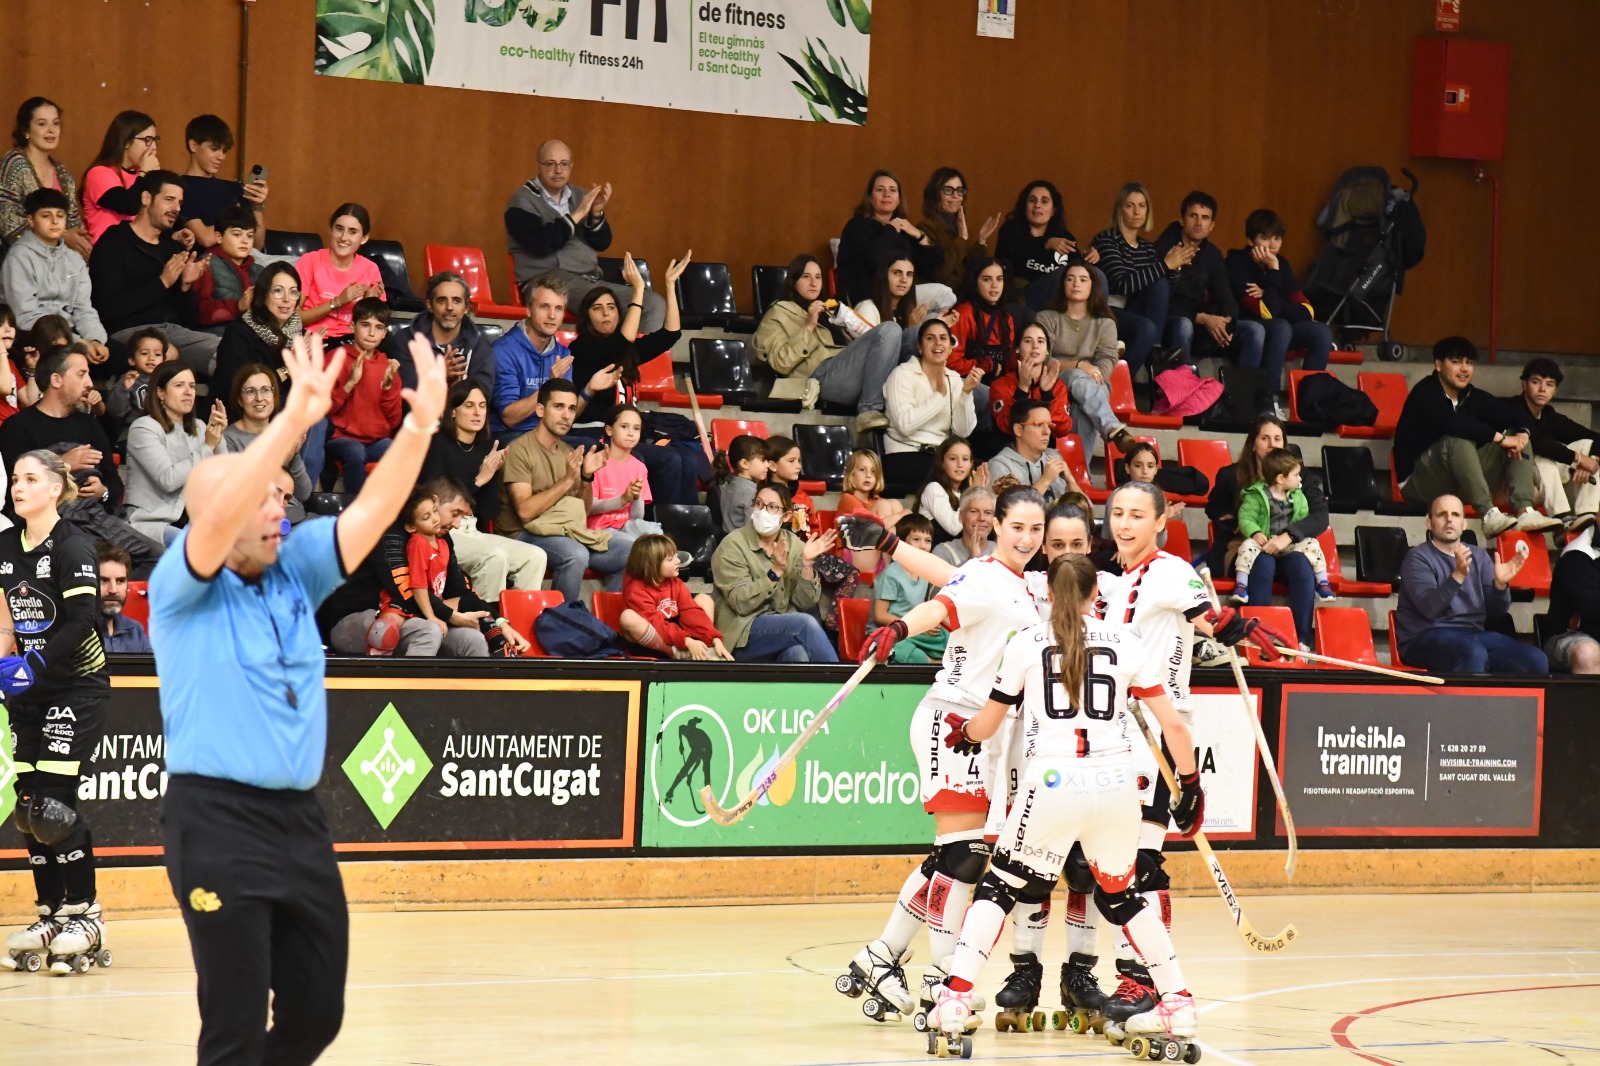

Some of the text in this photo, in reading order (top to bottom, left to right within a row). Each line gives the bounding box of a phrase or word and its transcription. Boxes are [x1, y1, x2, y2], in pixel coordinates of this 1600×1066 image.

[698, 1, 786, 30] de fitness
[698, 31, 765, 50] El teu gimnàs
[500, 44, 644, 70] eco-healthy fitness 24h
[698, 47, 760, 66] eco-healthy
[697, 61, 762, 80] a Sant Cugat
[9, 595, 44, 609] Estrella
[12, 606, 45, 621] Galicia
[23, 638, 47, 646] XUNTA
[1168, 635, 1184, 666] Cugat
[1041, 645, 1118, 722] 66
[743, 707, 777, 734] OK
[442, 734, 603, 759] AJUNTAMENT DE
[1317, 725, 1406, 749] Invisible
[1460, 744, 1469, 753] 20
[1469, 744, 1478, 753] 27
[1478, 744, 1487, 753] 59
[967, 757, 980, 780] 4
[1320, 748, 1402, 783] training
[1439, 758, 1518, 768] INVISIBLE-TRAINING.COM
[439, 761, 601, 806] SantCugat
[1010, 767, 1019, 793] 9
[1439, 773, 1456, 781] SANT
[1456, 773, 1478, 782] CUGAT
[1478, 773, 1492, 782] DEL
[1303, 787, 1341, 795] FISIOTERAPIA
[1345, 786, 1384, 796] READAPTACIÓ
[1384, 787, 1415, 796] ESPORTIVA
[1244, 931, 1286, 952] AZEMAD
